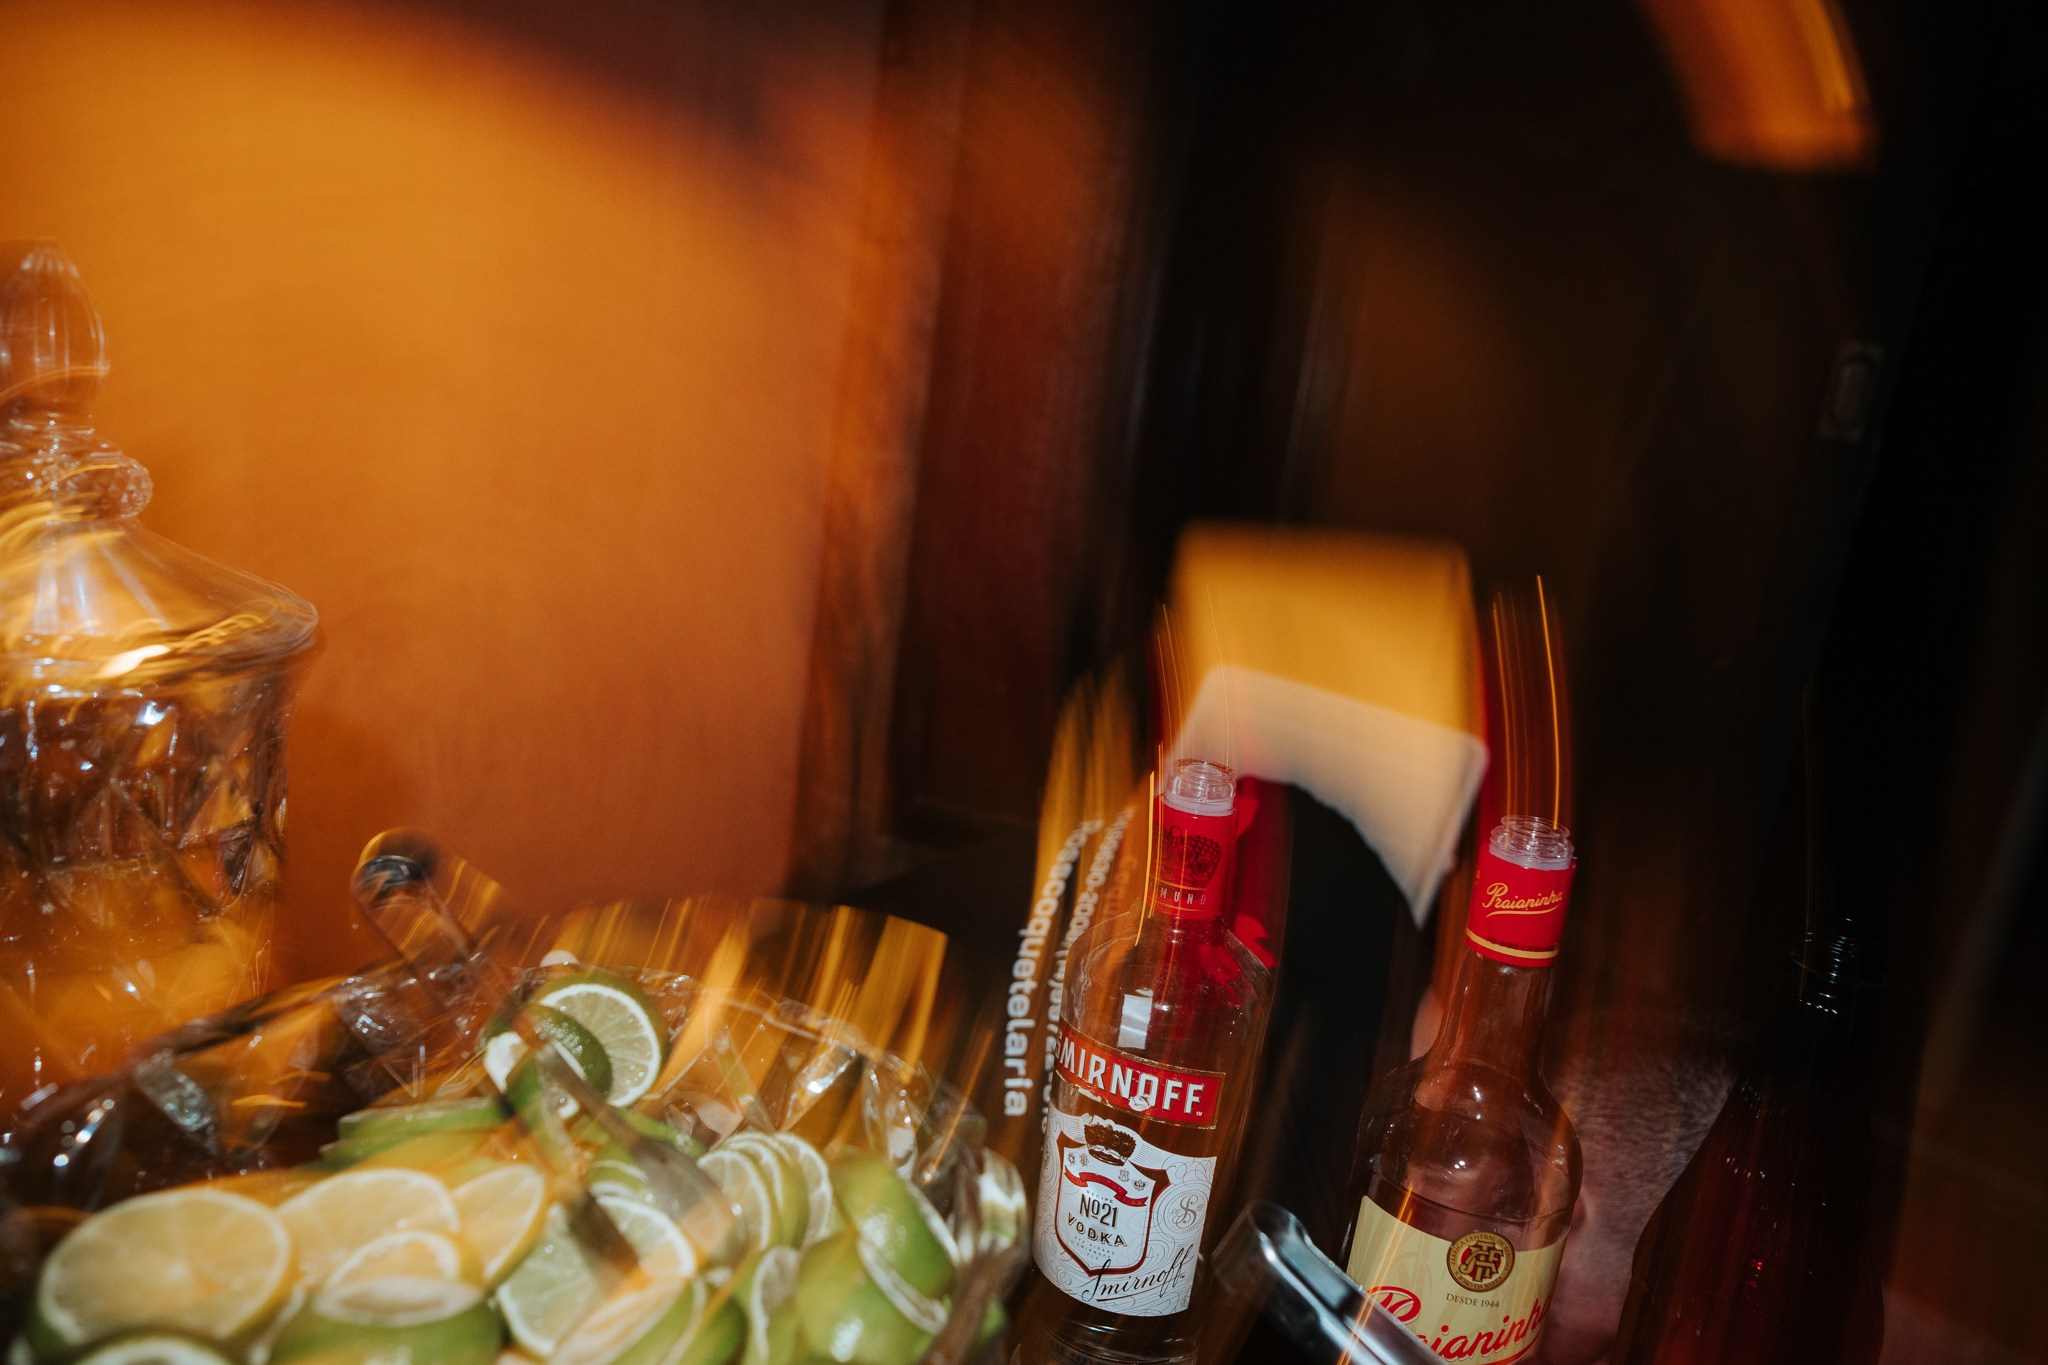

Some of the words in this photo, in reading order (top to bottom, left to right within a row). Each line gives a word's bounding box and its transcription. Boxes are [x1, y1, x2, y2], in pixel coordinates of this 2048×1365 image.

[1067, 1211, 1128, 1248] VODKA
[1080, 1244, 1194, 1302] Smirnoff
[1446, 1293, 1479, 1307] DESDE
[1481, 1299, 1500, 1309] 1944
